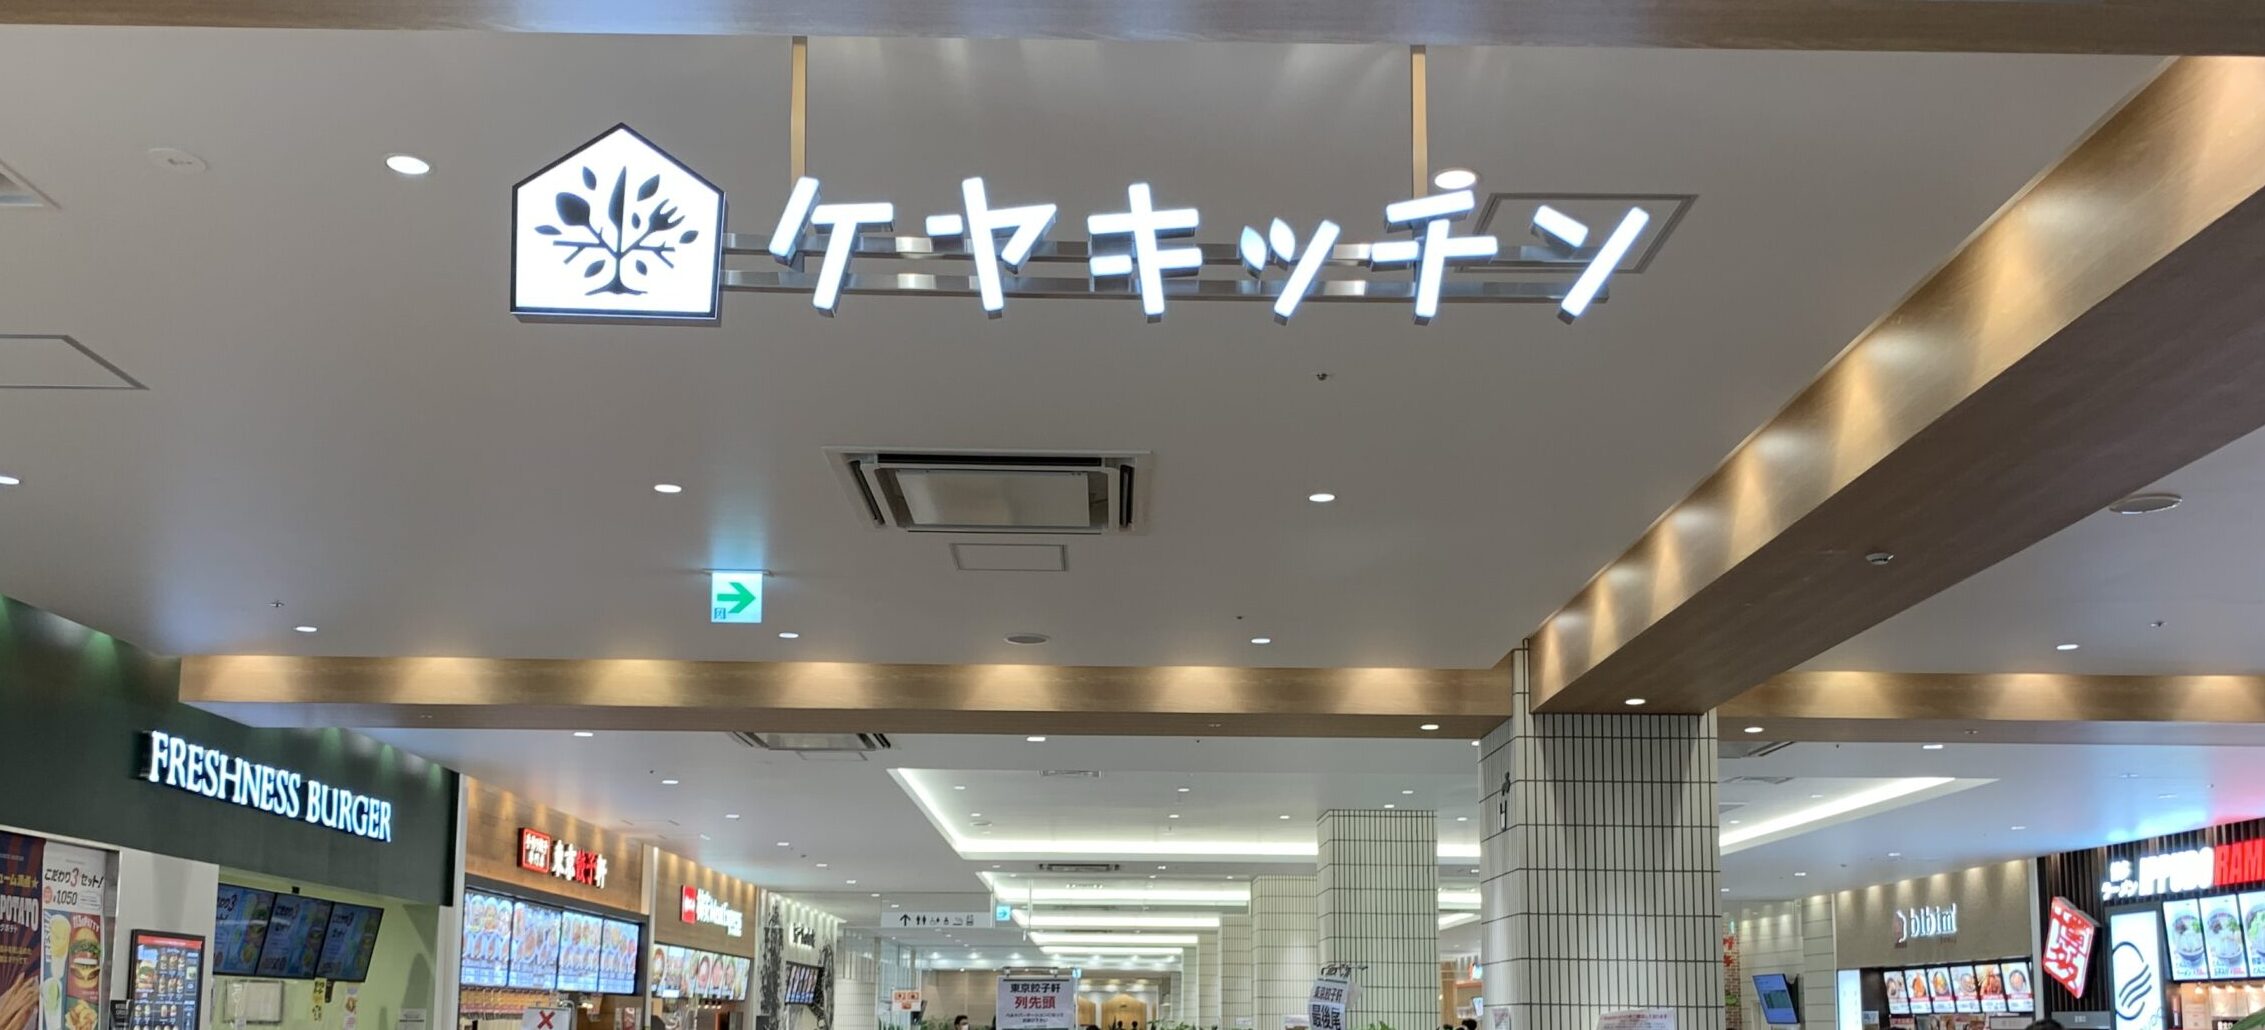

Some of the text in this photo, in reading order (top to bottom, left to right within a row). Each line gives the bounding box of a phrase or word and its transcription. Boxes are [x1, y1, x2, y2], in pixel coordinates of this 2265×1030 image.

[768, 176, 1650, 321] ケヤキッチン
[149, 730, 392, 843] FRESHNESS BURGER
[2215, 838, 2265, 886] RAM
[1010, 983, 1061, 993] 東京餃子軒
[1014, 996, 1056, 1009] 列先頭
[1311, 1004, 1341, 1030] 最後尾
